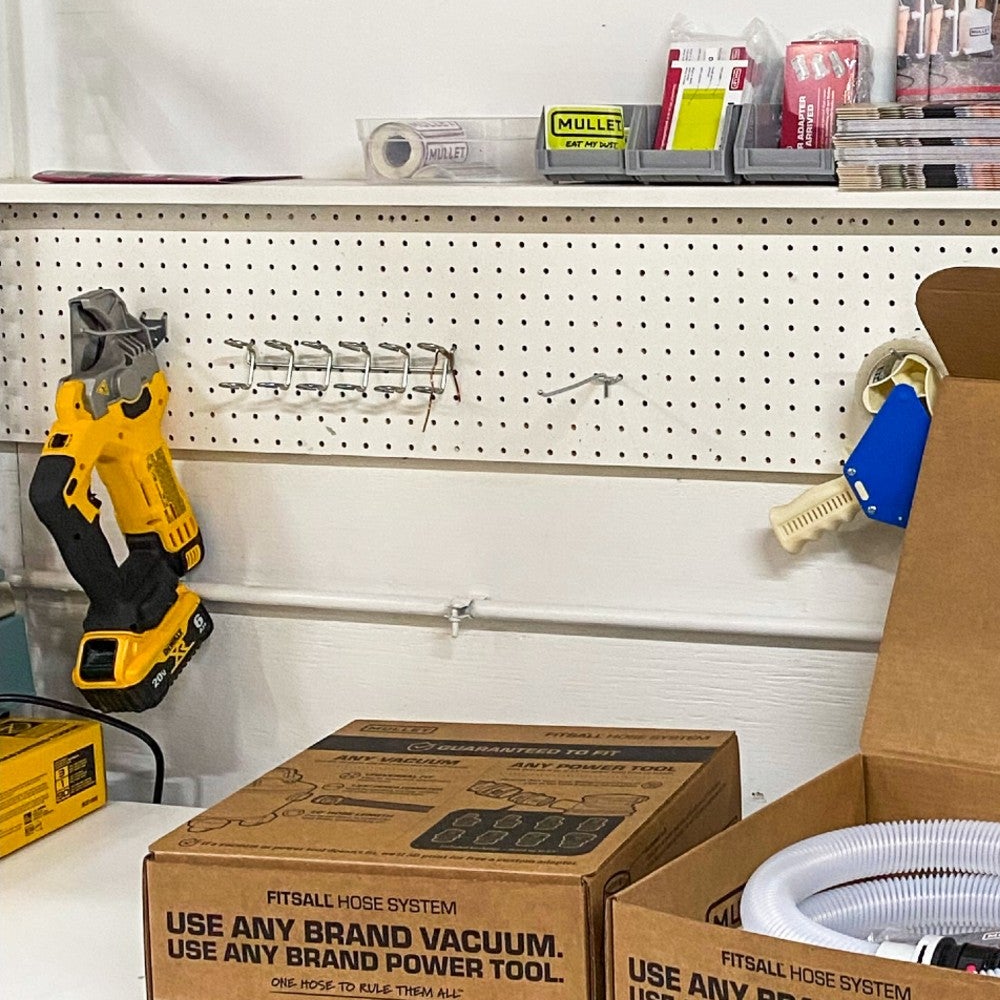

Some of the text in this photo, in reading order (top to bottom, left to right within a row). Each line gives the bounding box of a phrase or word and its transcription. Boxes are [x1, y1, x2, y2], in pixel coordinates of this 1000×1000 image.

[558, 118, 622, 132] MULLET
[797, 95, 806, 141] ADAPTER
[805, 104, 814, 147] ARRIVED
[429, 146, 466, 161] MULLET
[193, 613, 204, 629] 6
[334, 754, 461, 766] ANY VACUUM
[438, 744, 561, 755] GUARANTEED
[594, 749, 622, 757] FIT
[511, 761, 554, 769] ANY
[556, 763, 630, 771] POWER
[267, 890, 457, 915] FITSALL HOSE SYSTEM
[166, 911, 564, 958] USE ANY BRAND VACUUM.
[167, 938, 564, 983] USE ANY BRAND POWER TOOL.
[270, 977, 297, 988] ONE
[300, 979, 335, 991] HOSE
[338, 981, 355, 992] TO
[359, 982, 392, 995] RULE
[395, 984, 433, 998] THEM
[628, 956, 682, 993] USE
[688, 971, 749, 1000] ANY
[790, 964, 836, 989] HOSE
[839, 974, 911, 1000] SYSTEM
